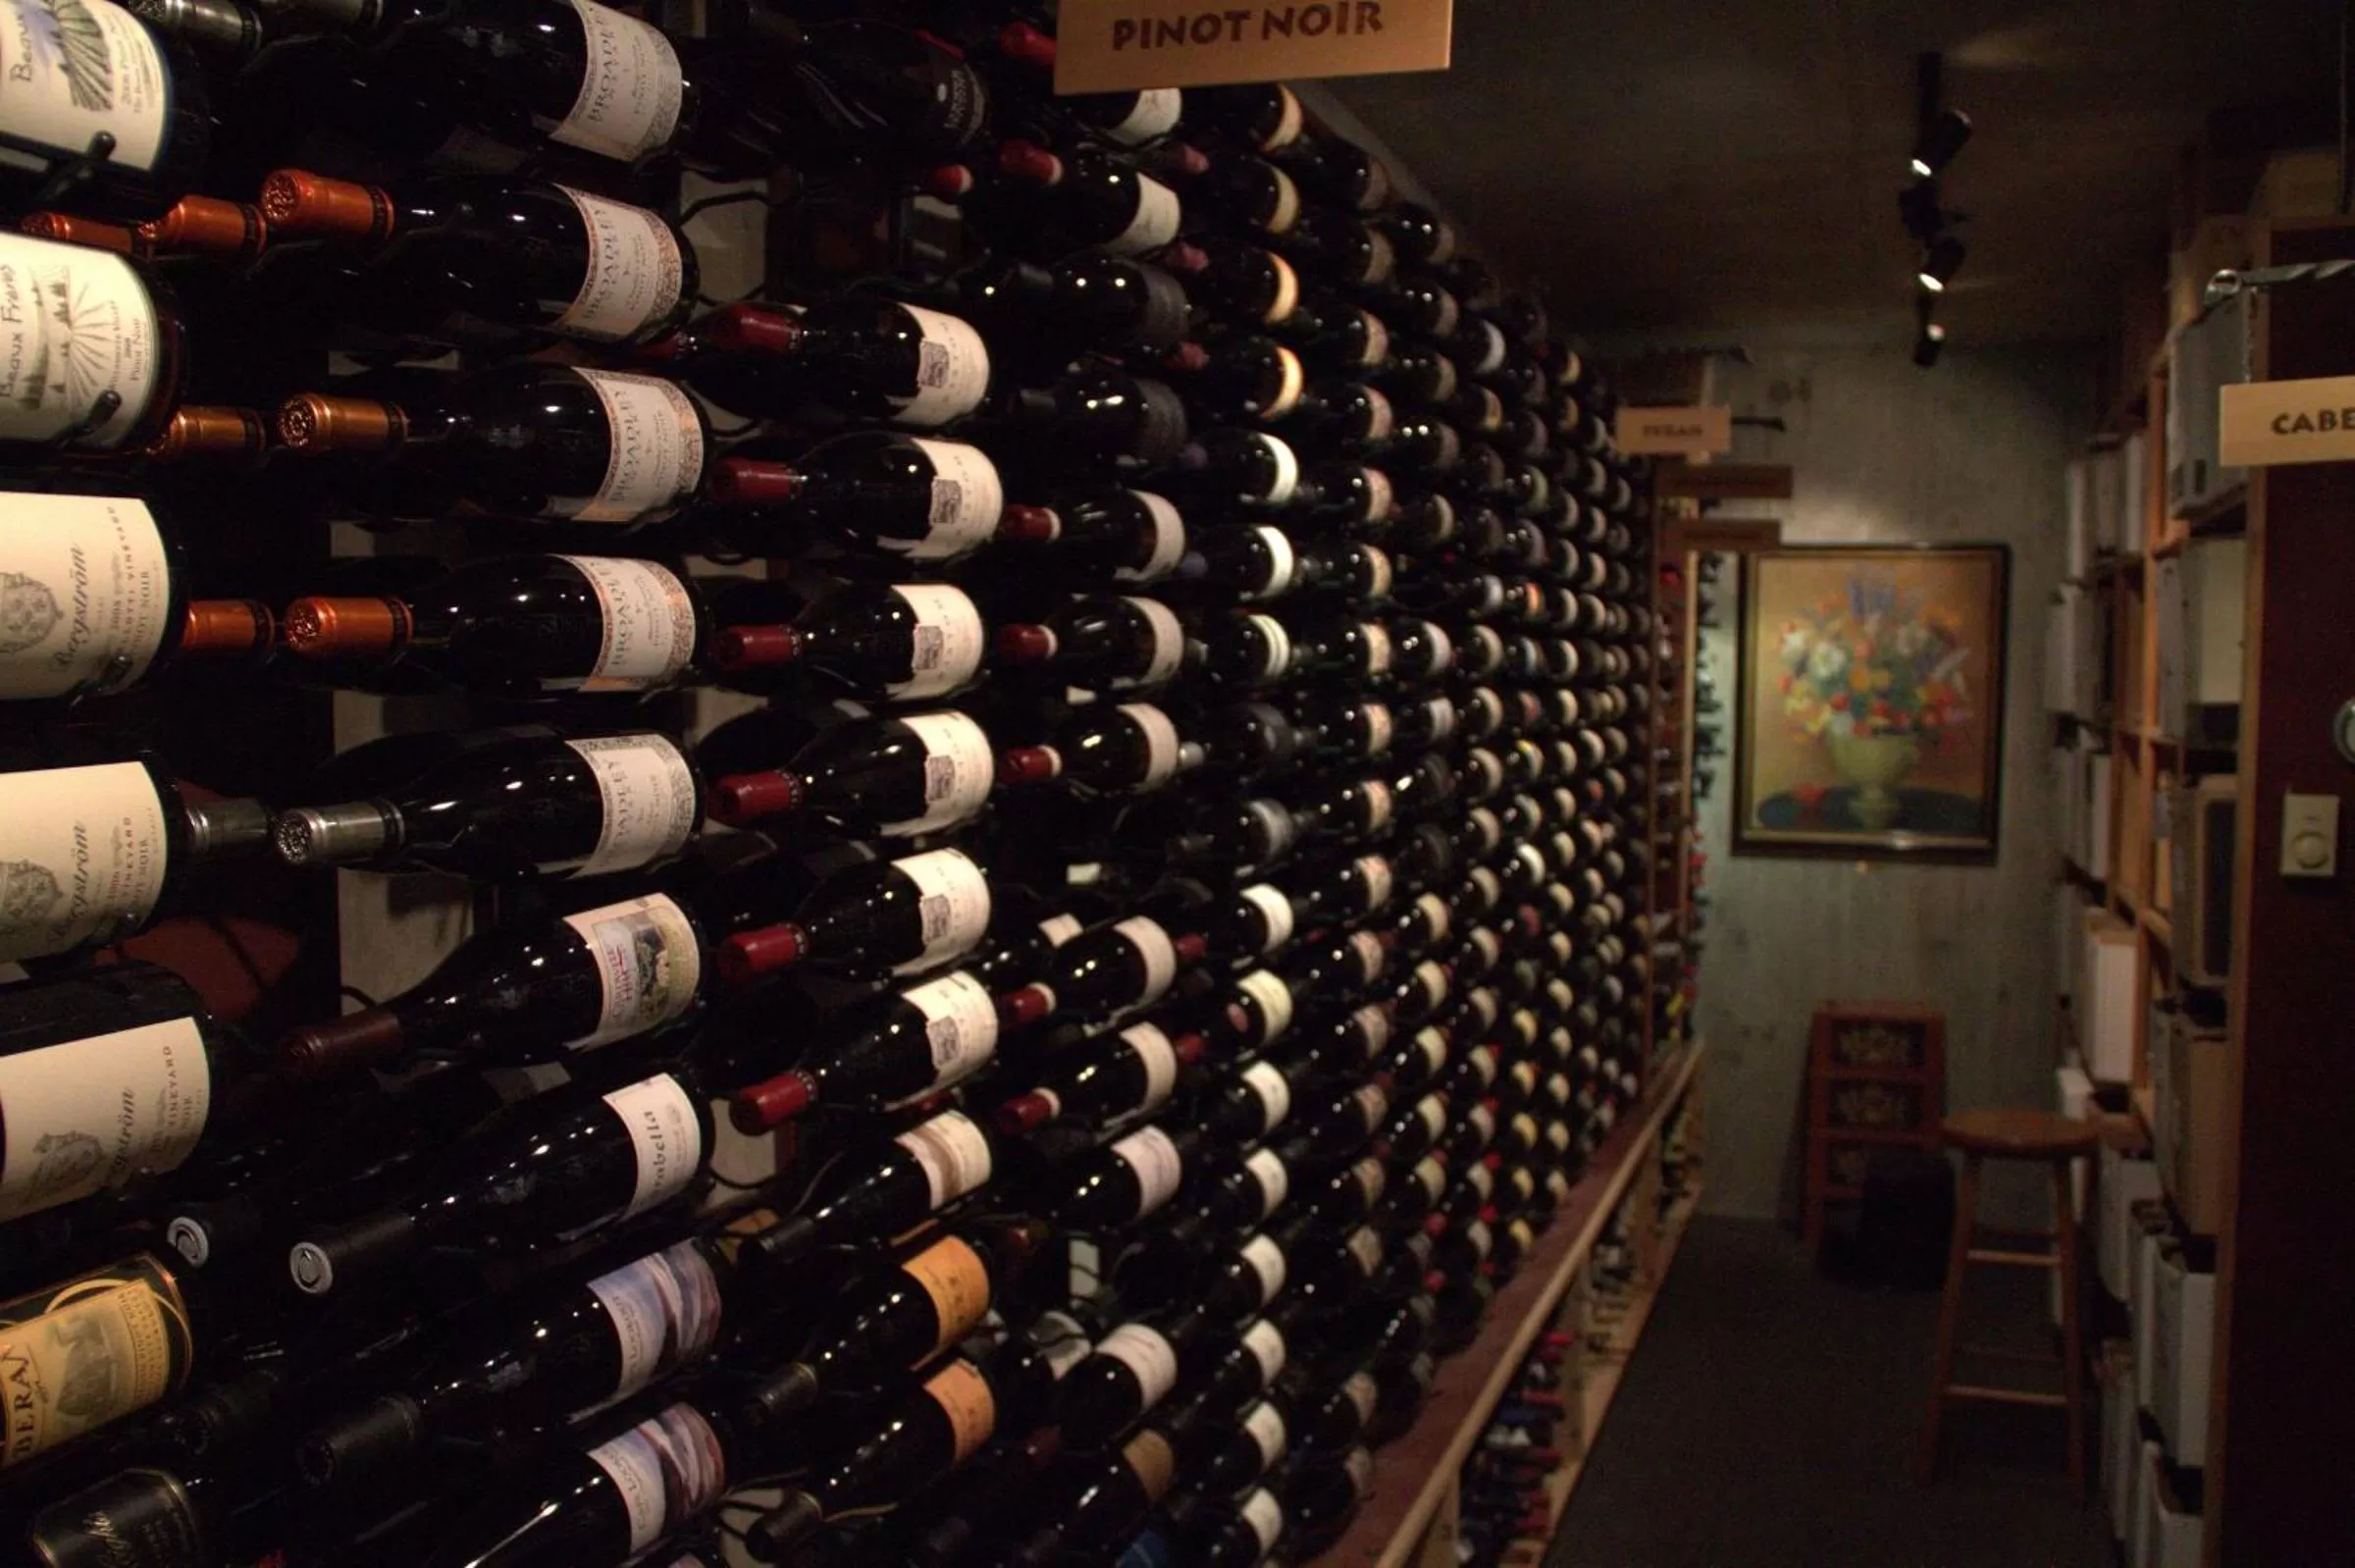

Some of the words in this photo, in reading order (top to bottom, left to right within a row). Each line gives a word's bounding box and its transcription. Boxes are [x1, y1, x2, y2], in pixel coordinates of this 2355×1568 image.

[1112, 10, 1251, 50] PINOT
[1261, 1, 1384, 40] NOIR
[0, 332, 22, 397] Beaux
[2271, 407, 2355, 435] CABE
[643, 1111, 666, 1201] arabella
